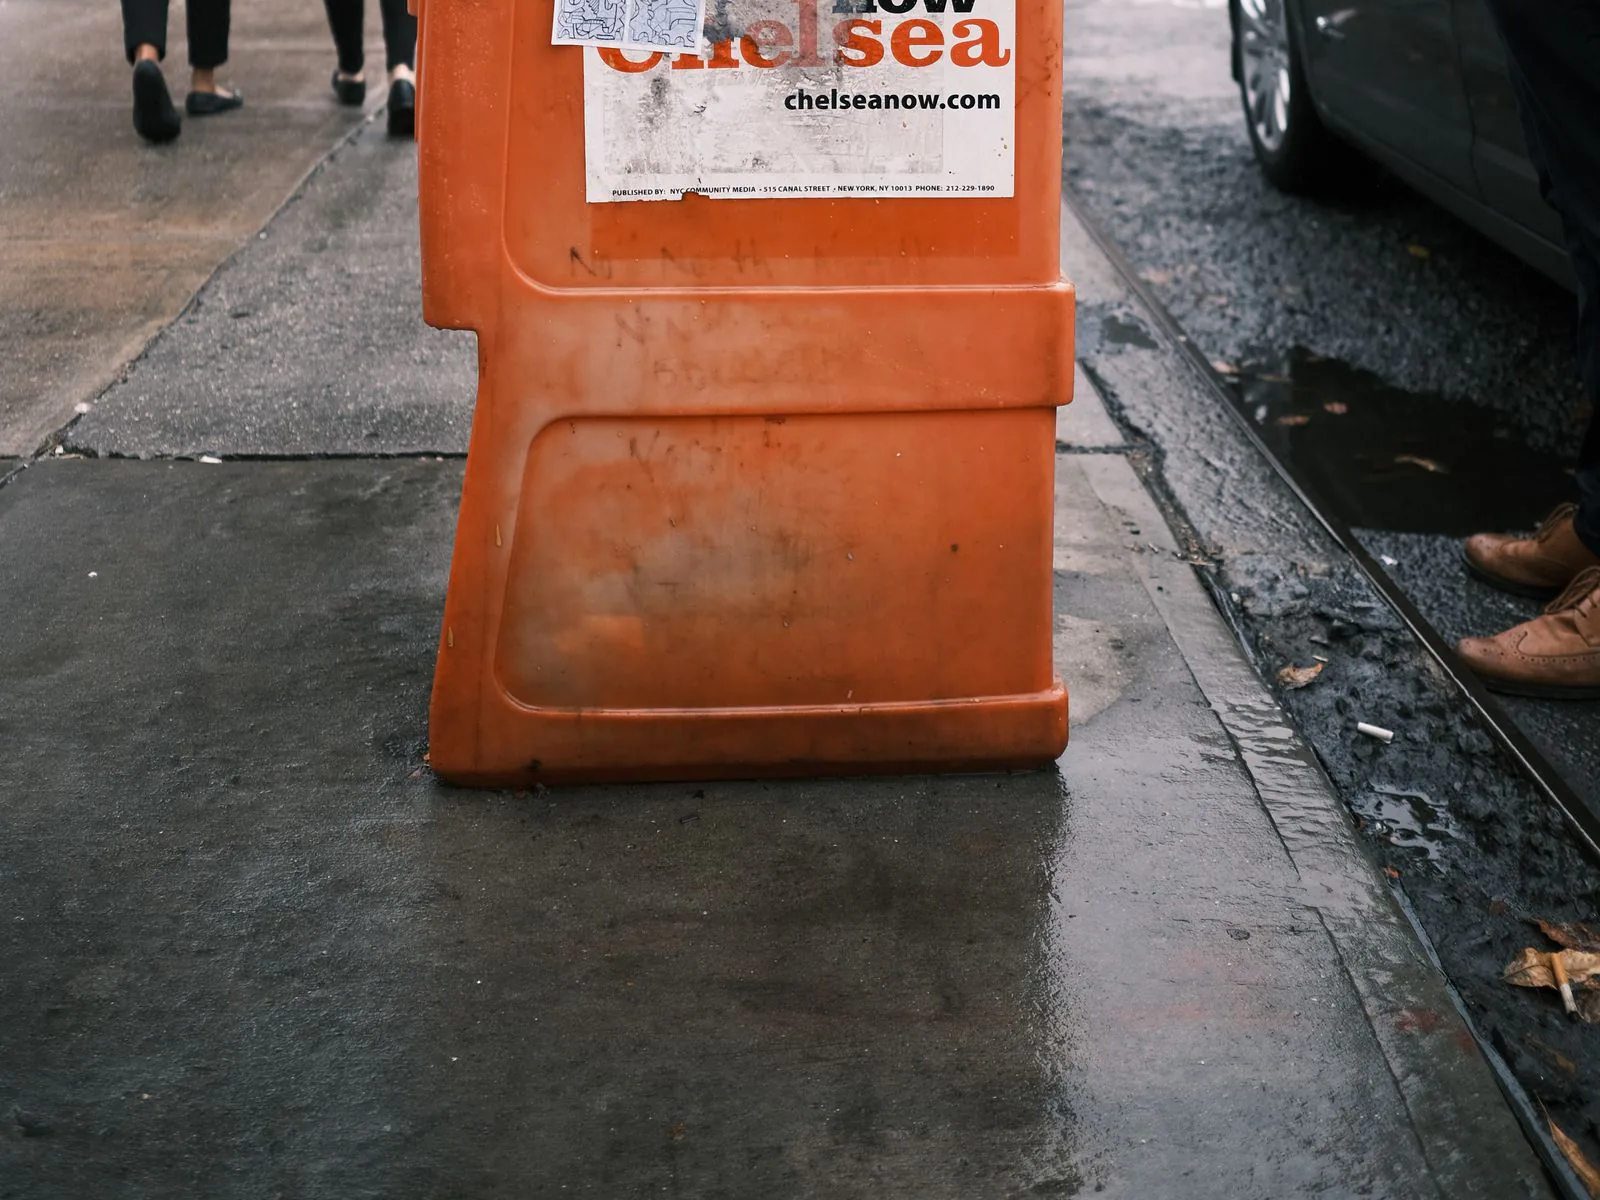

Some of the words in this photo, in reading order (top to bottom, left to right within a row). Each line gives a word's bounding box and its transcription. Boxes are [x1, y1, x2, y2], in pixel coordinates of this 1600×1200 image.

[784, 89, 1001, 110] chelseanow.com
[612, 188, 653, 196] PUBLISHED
[670, 187, 684, 195] NYC
[778, 185, 802, 193] CANAL
[804, 185, 830, 193] STREET
[837, 185, 854, 193] NEW
[855, 185, 877, 193] YORK,
[879, 185, 889, 193] NY
[891, 185, 912, 193] 10013
[915, 185, 943, 193] PHONE:
[946, 185, 995, 193] 212-229-1890
